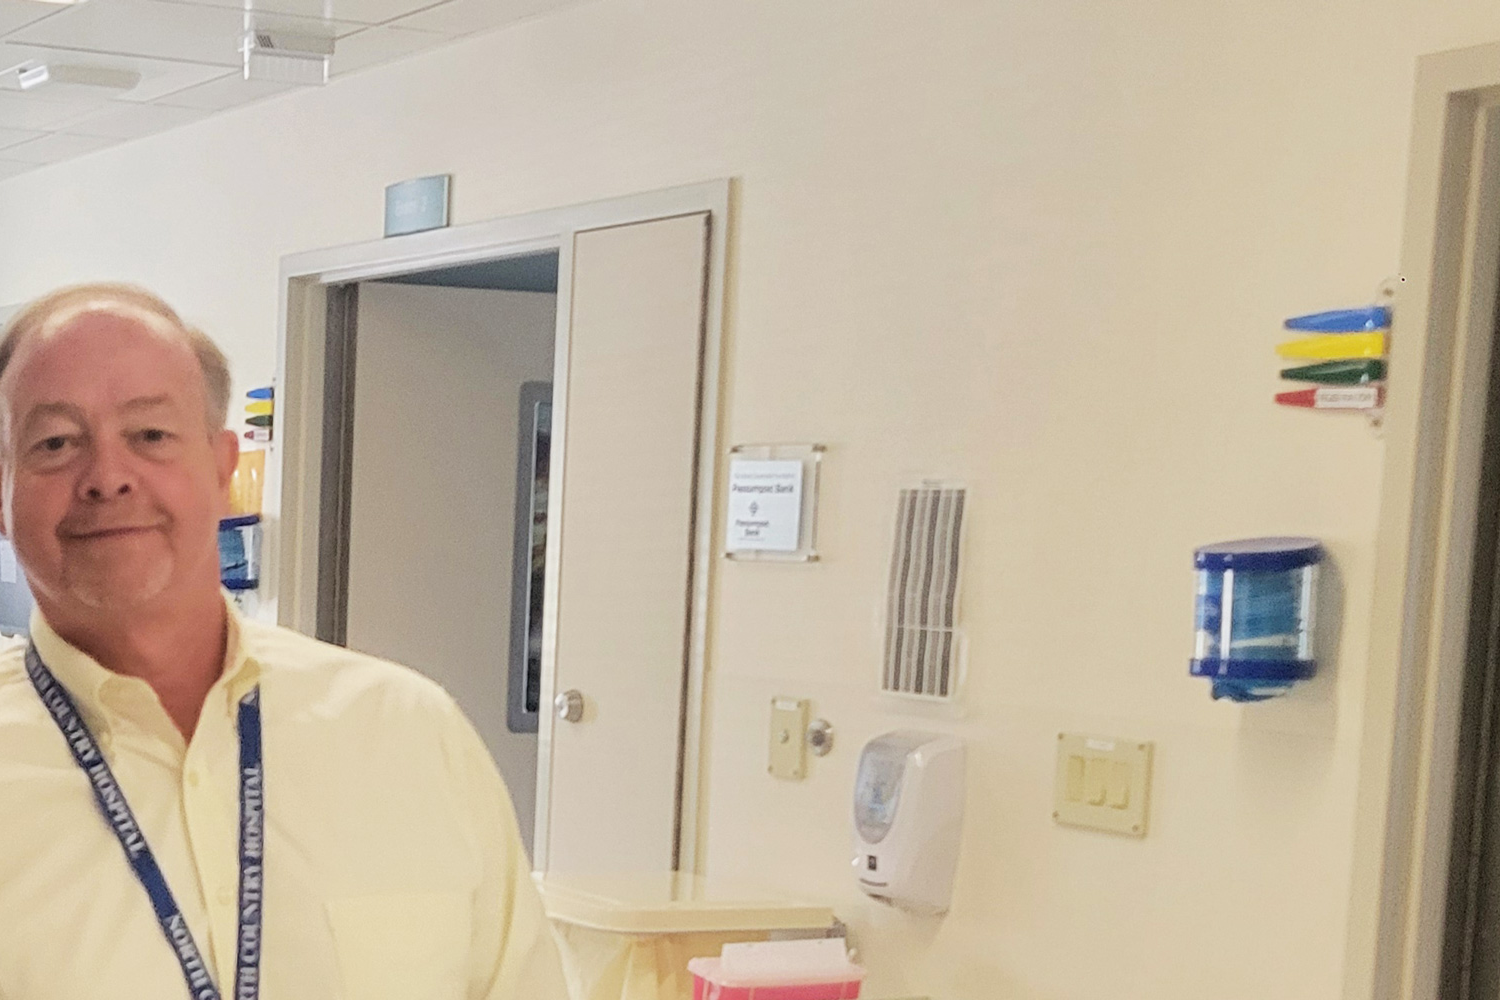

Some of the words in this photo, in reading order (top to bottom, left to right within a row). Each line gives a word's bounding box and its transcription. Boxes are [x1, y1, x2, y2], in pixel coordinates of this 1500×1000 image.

[88, 762, 145, 857] HOSPITAL
[243, 765, 261, 858] HOSPITAL
[163, 914, 209, 989] NORTH
[239, 866, 260, 965] COUNTRY
